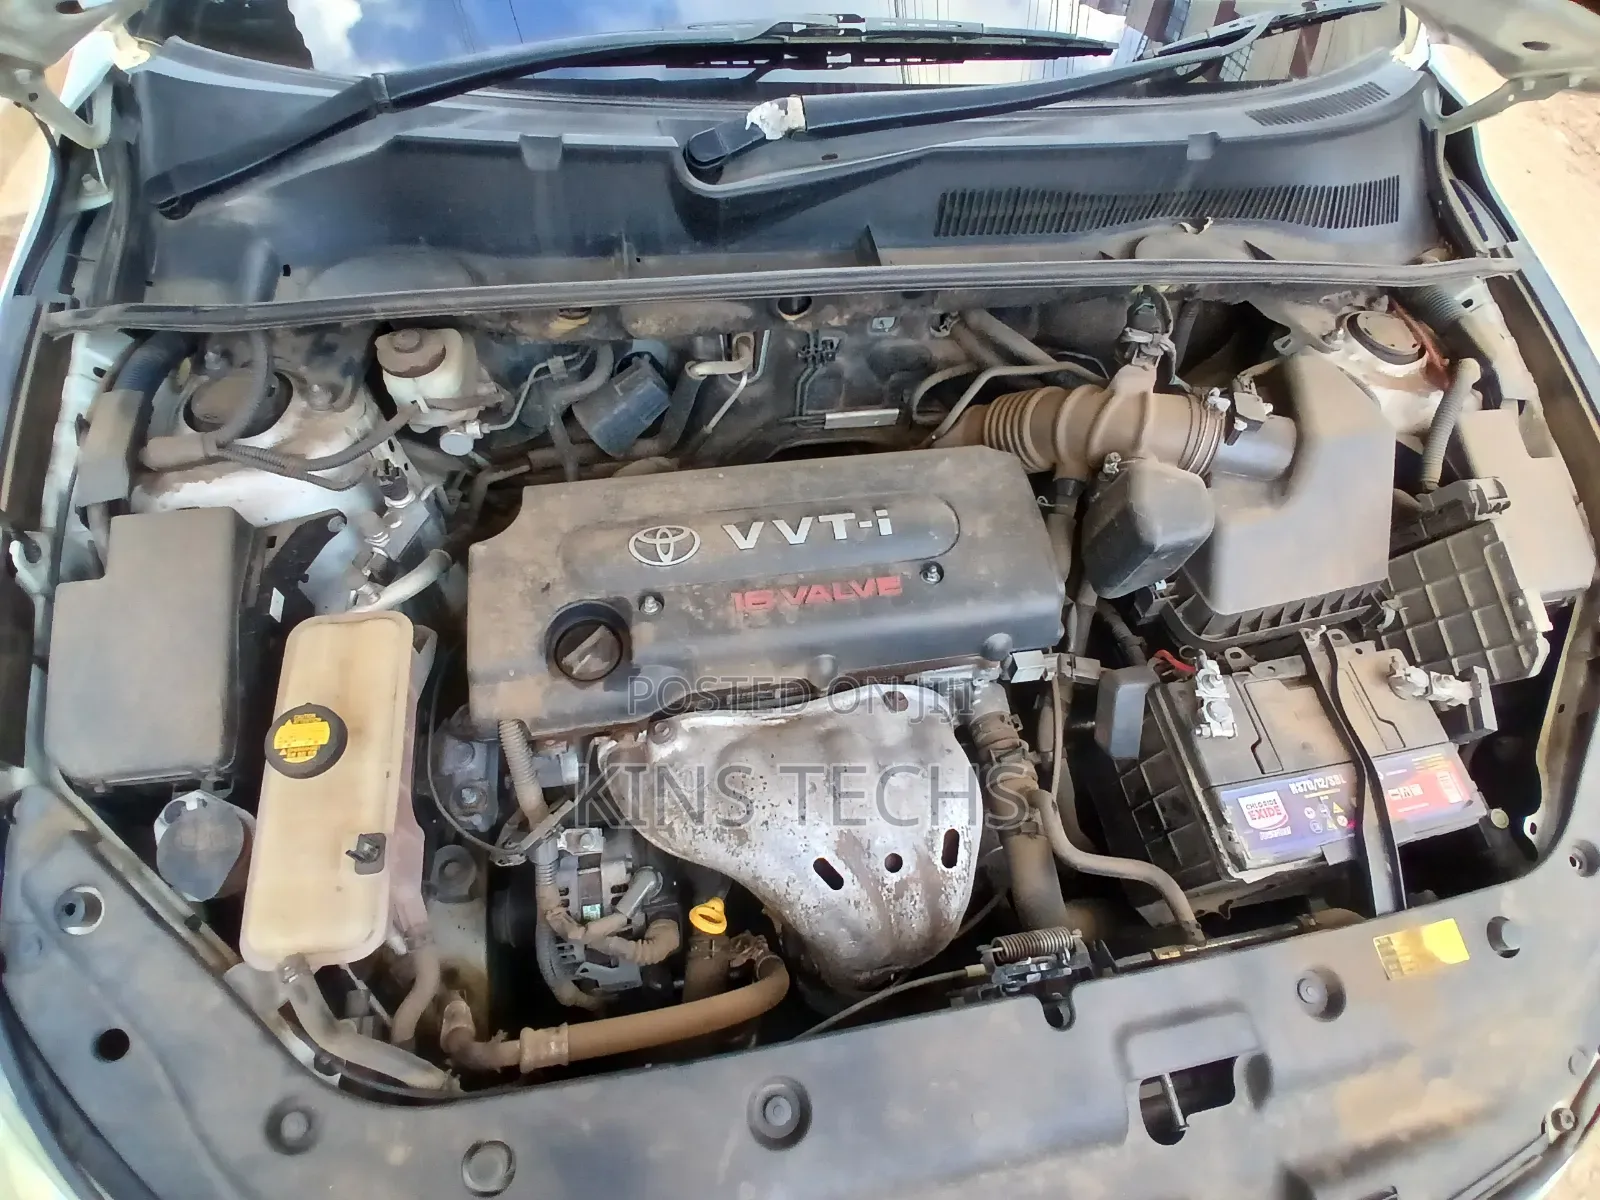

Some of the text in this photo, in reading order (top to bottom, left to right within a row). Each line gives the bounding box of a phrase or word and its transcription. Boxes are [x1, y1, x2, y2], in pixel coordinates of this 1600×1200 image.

[721, 509, 893, 550] VVT-i
[731, 575, 903, 612] 16 VALVE
[1247, 805, 1283, 821] EXIDE
